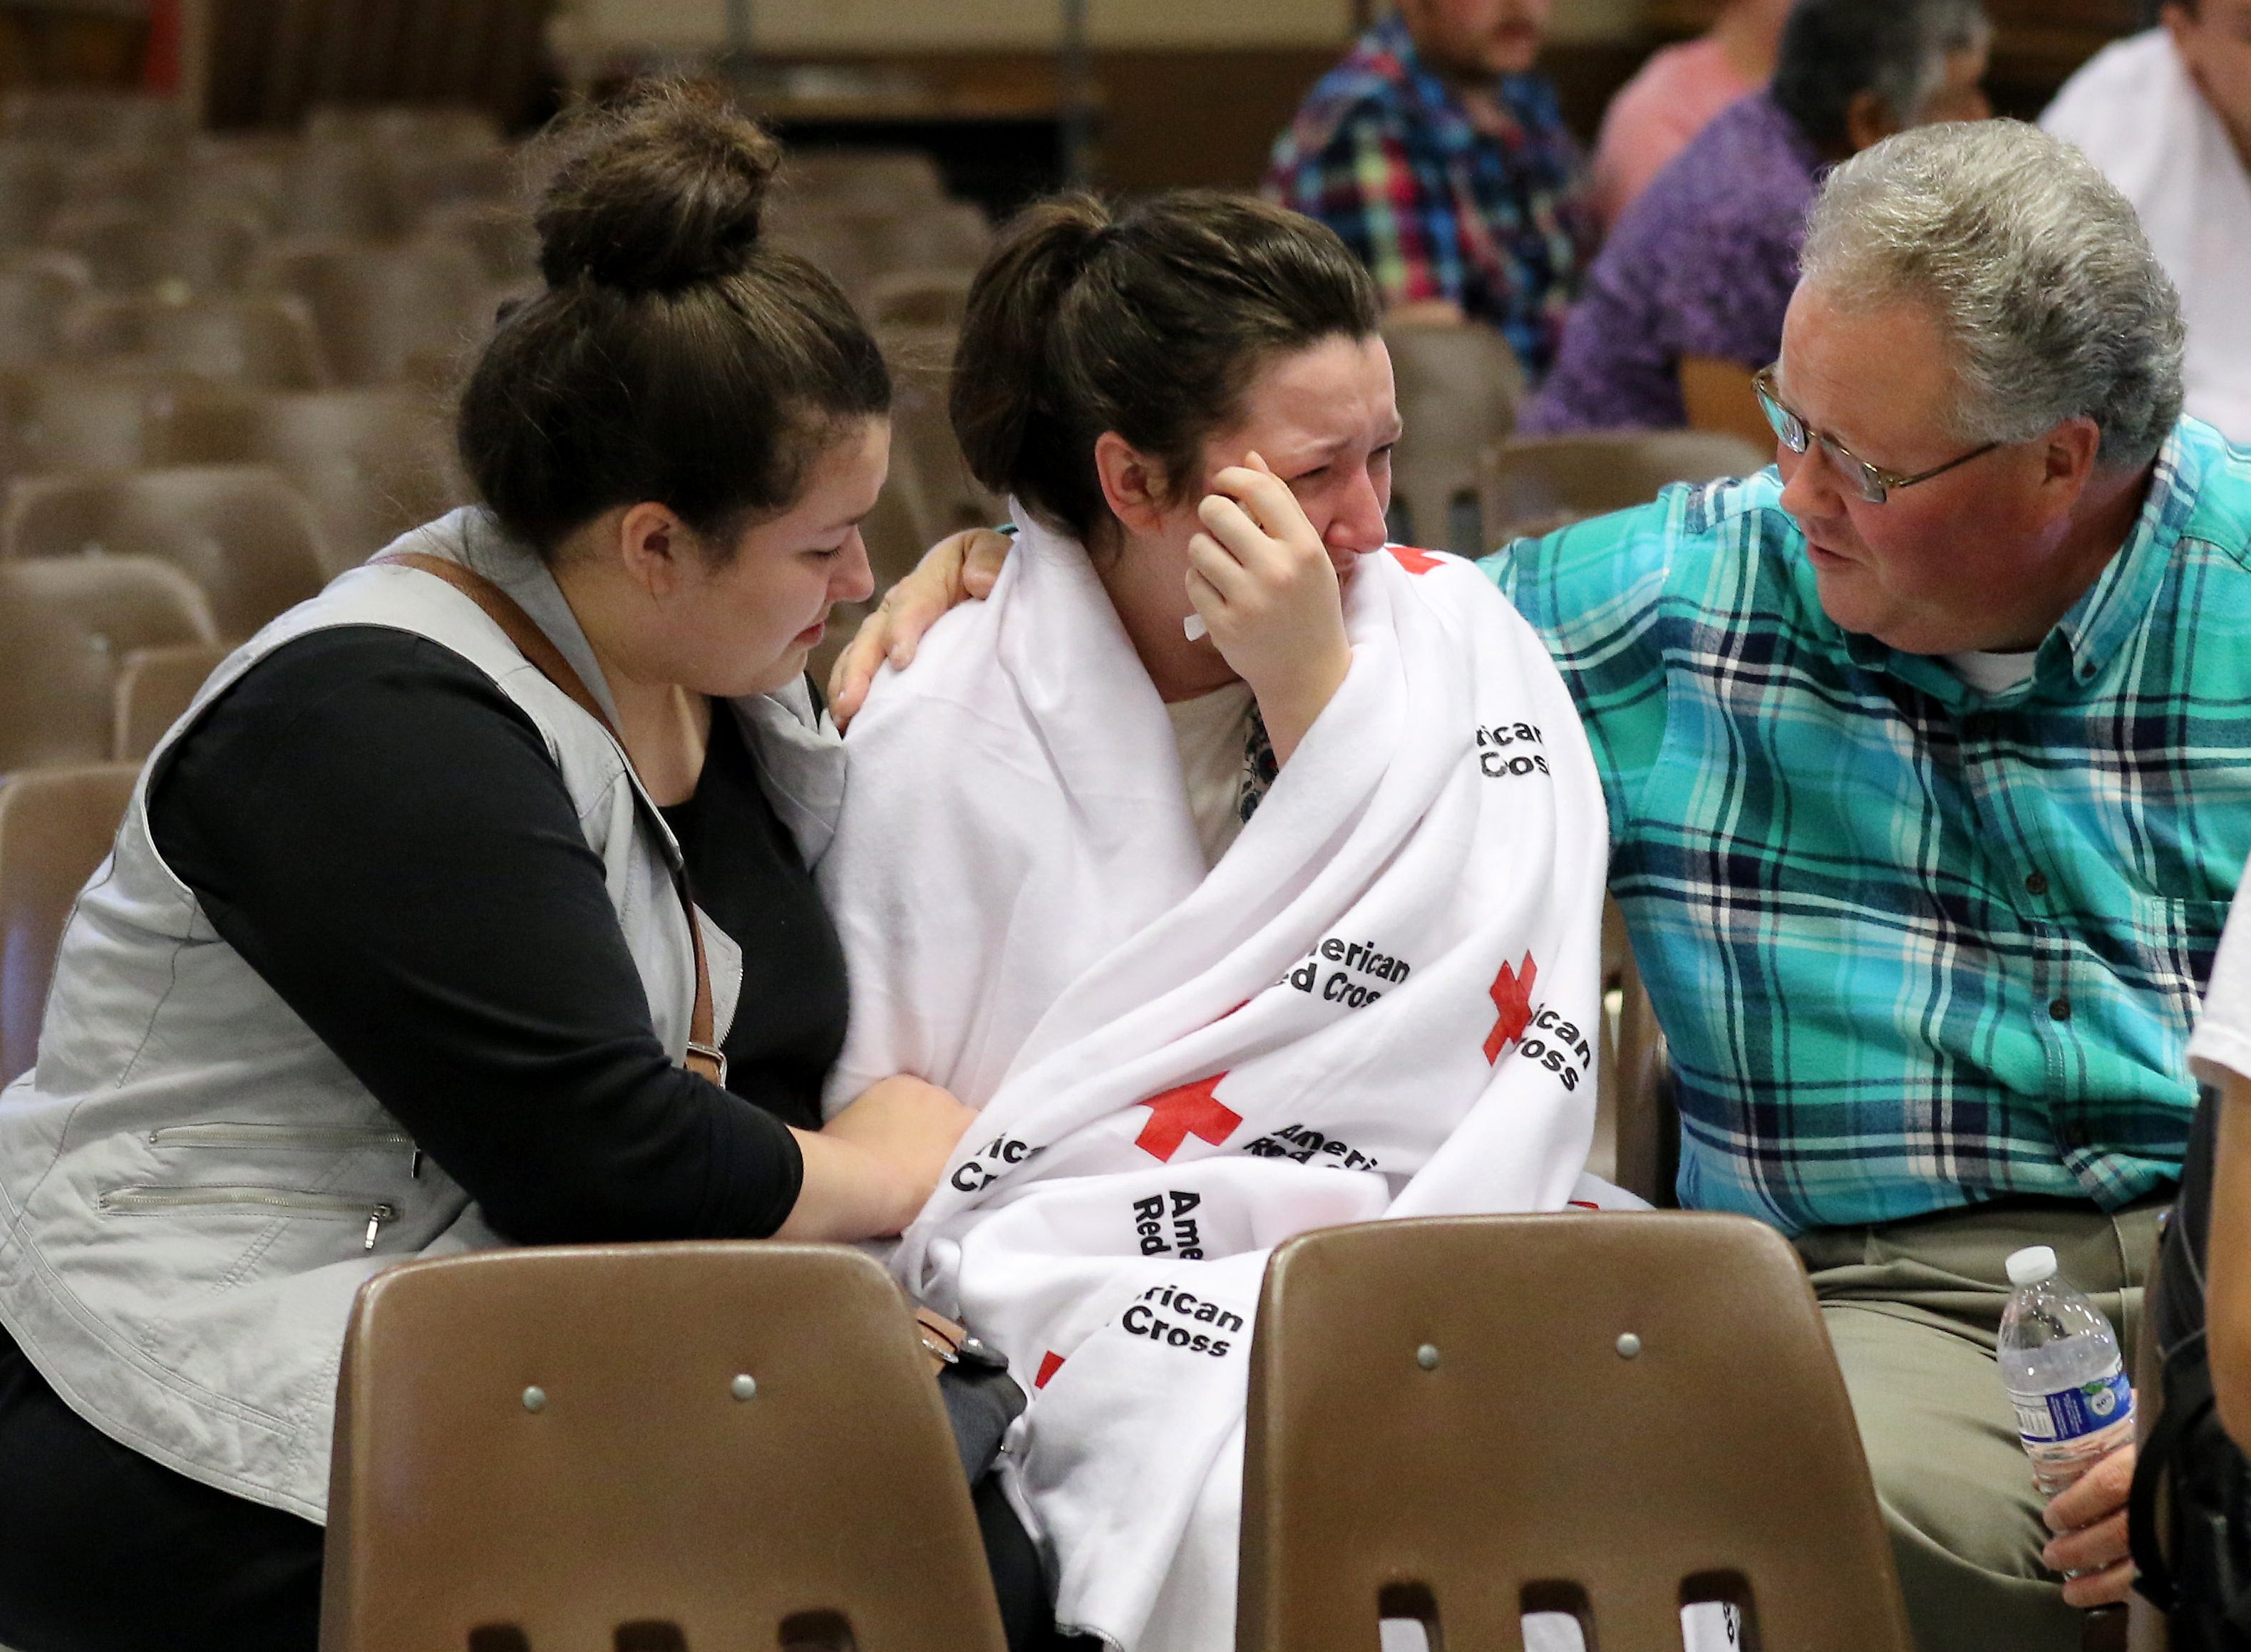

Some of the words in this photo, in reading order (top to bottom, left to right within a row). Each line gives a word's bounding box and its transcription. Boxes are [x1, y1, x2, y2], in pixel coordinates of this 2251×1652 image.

[1309, 938, 1410, 984] erican
[1133, 1194, 1172, 1256] Red
[1123, 1306, 1231, 1357] Cross
[1135, 1285, 1244, 1332] rican
